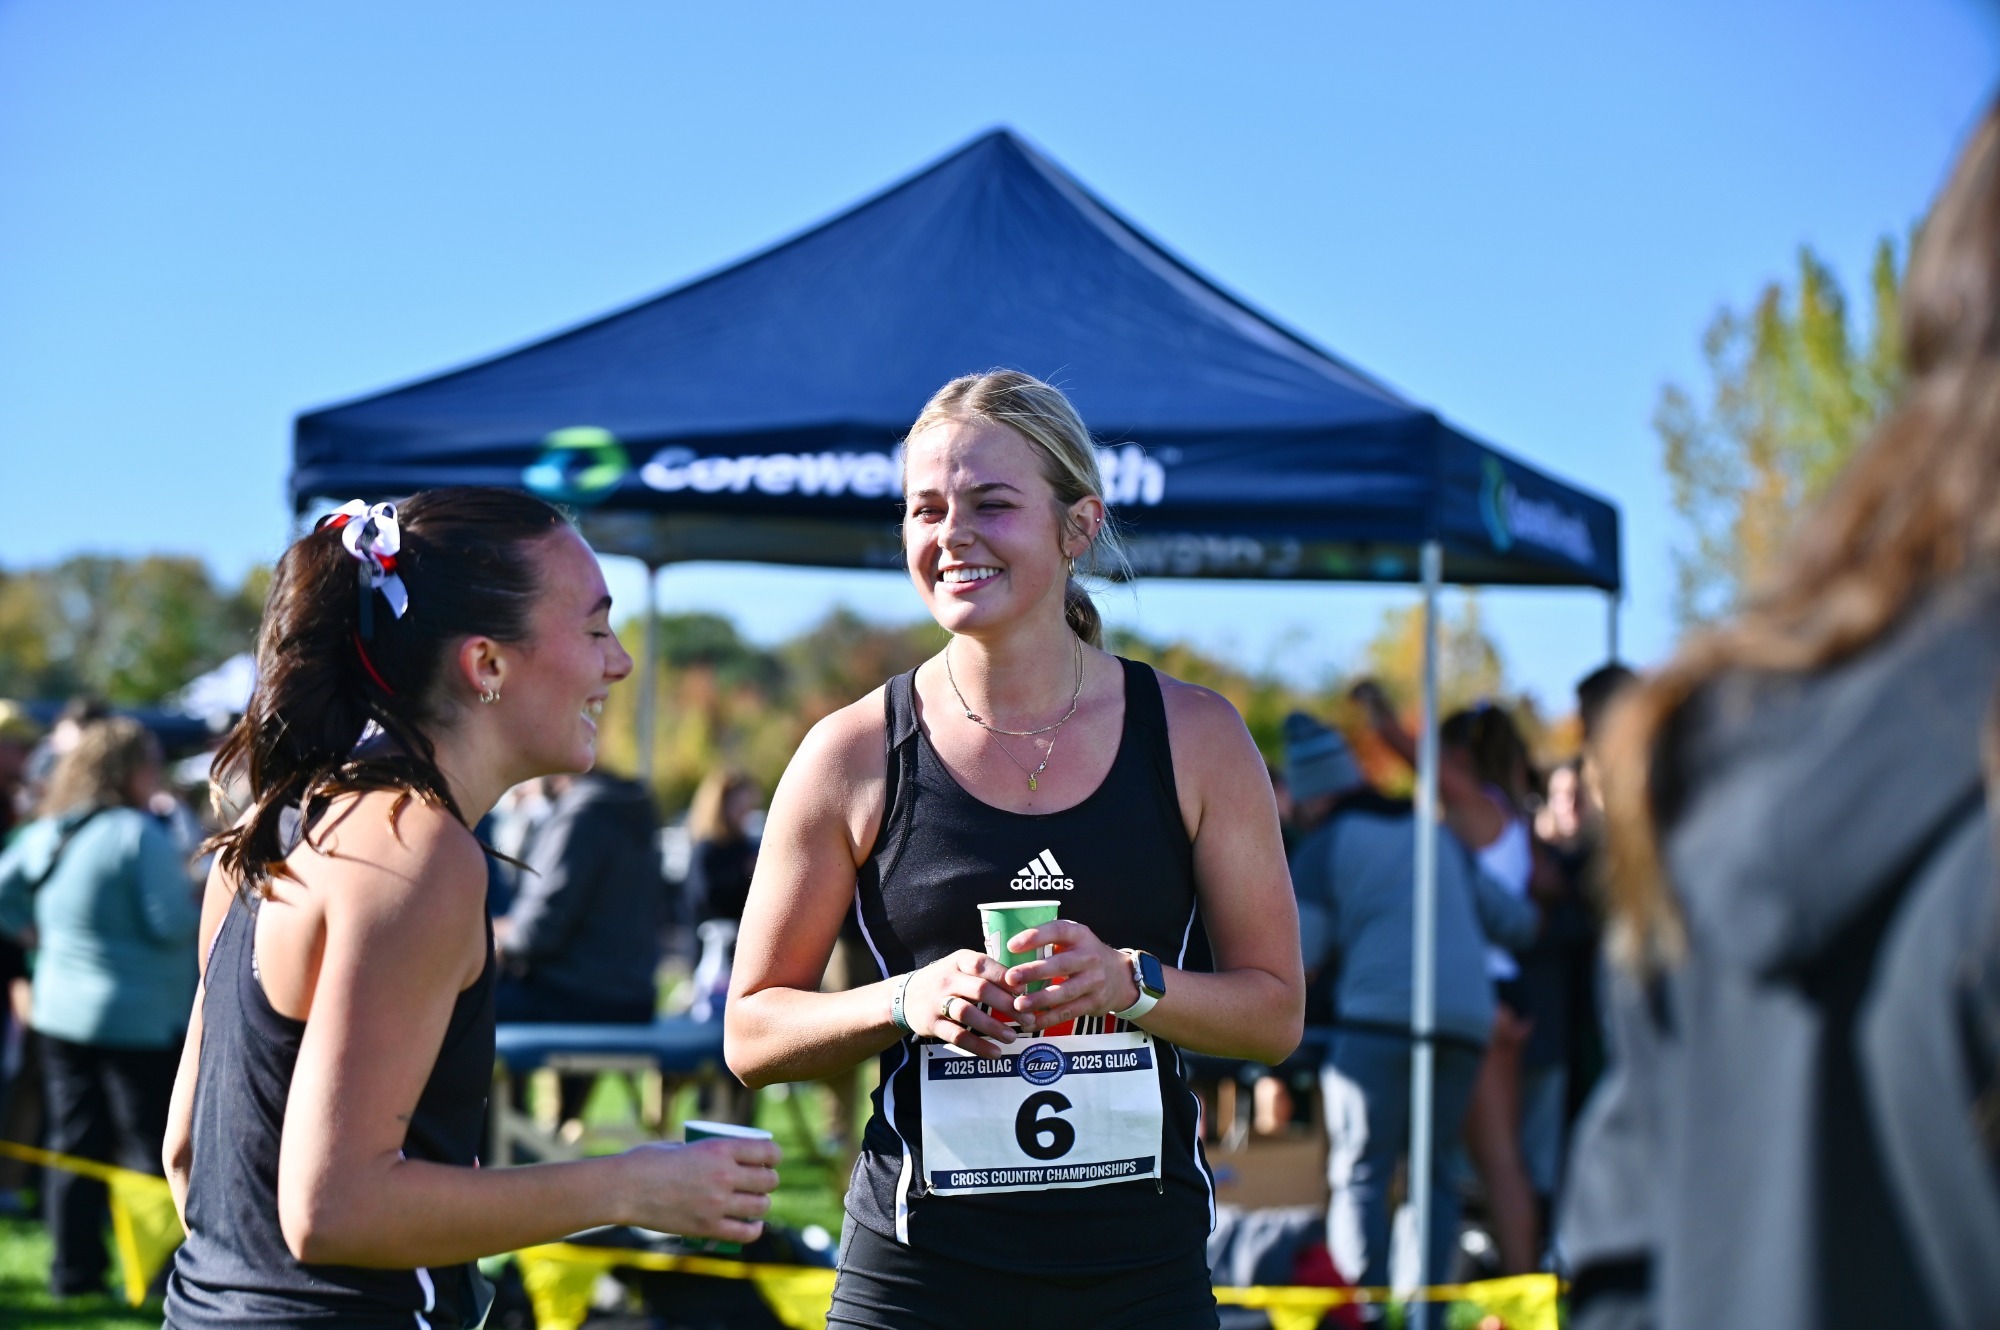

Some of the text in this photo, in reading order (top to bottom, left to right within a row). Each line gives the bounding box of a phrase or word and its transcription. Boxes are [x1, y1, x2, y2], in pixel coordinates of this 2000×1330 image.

[1010, 874, 1074, 891] adidas
[944, 1058, 1012, 1076] 2025 GLIAC
[1027, 1061, 1059, 1071] GLIAC
[1072, 1052, 1138, 1070] 2025 GLIAC
[1015, 1090, 1075, 1161] 6
[950, 1160, 1137, 1186] CROSS COUNTRY CHAMPIONSHIPS
